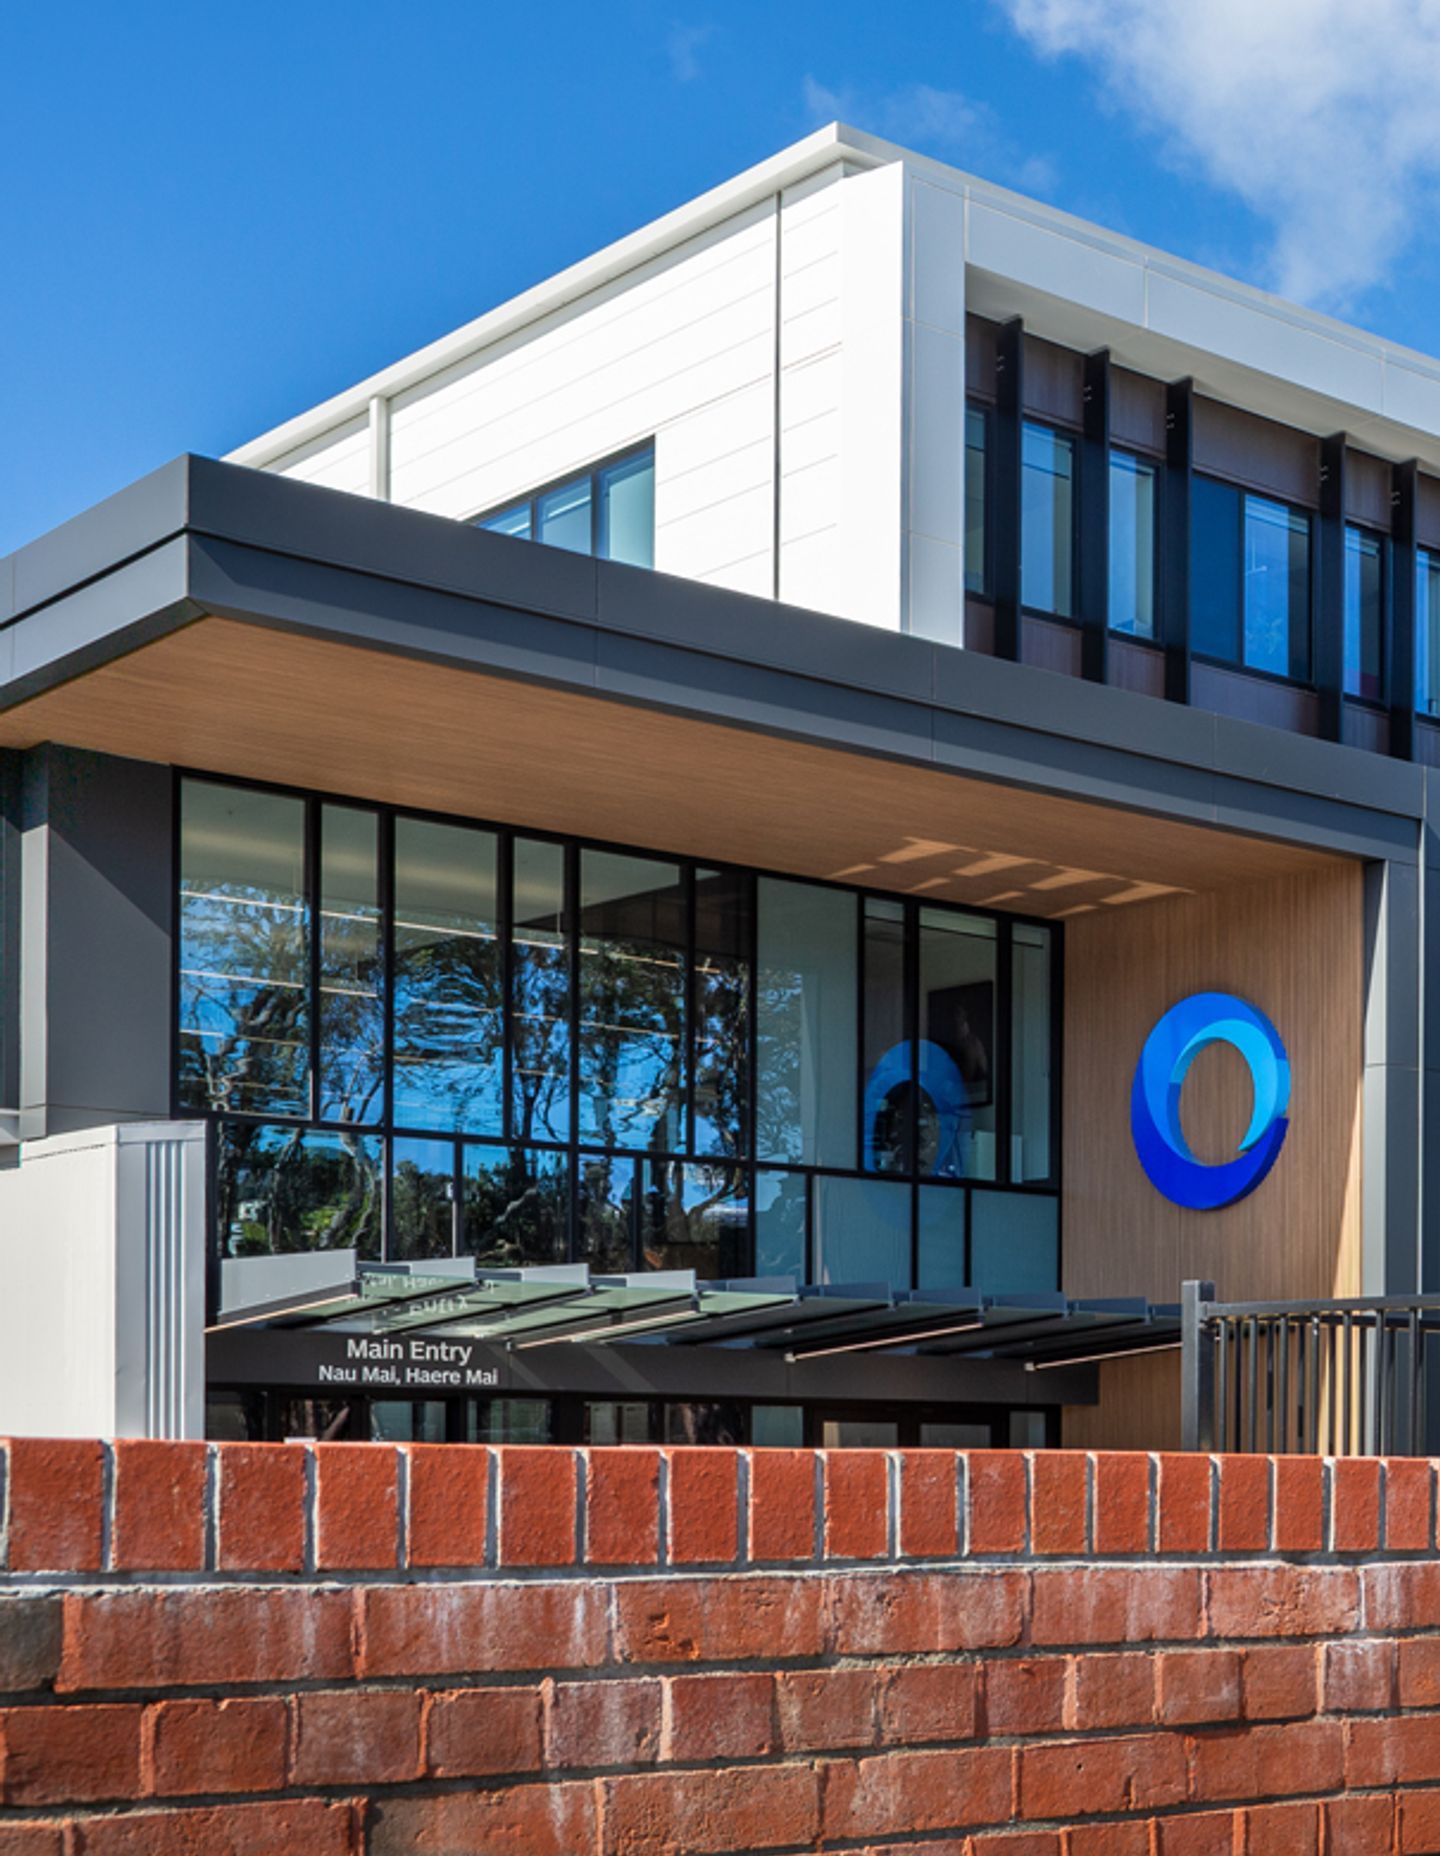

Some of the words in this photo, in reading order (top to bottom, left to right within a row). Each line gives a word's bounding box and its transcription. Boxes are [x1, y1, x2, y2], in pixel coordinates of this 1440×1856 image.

[347, 1338, 404, 1359] Main
[410, 1340, 473, 1366] Entry
[318, 1364, 356, 1382] Nau
[362, 1366, 400, 1386] Mai,
[406, 1367, 461, 1384] Haere
[466, 1368, 498, 1385] Mai
